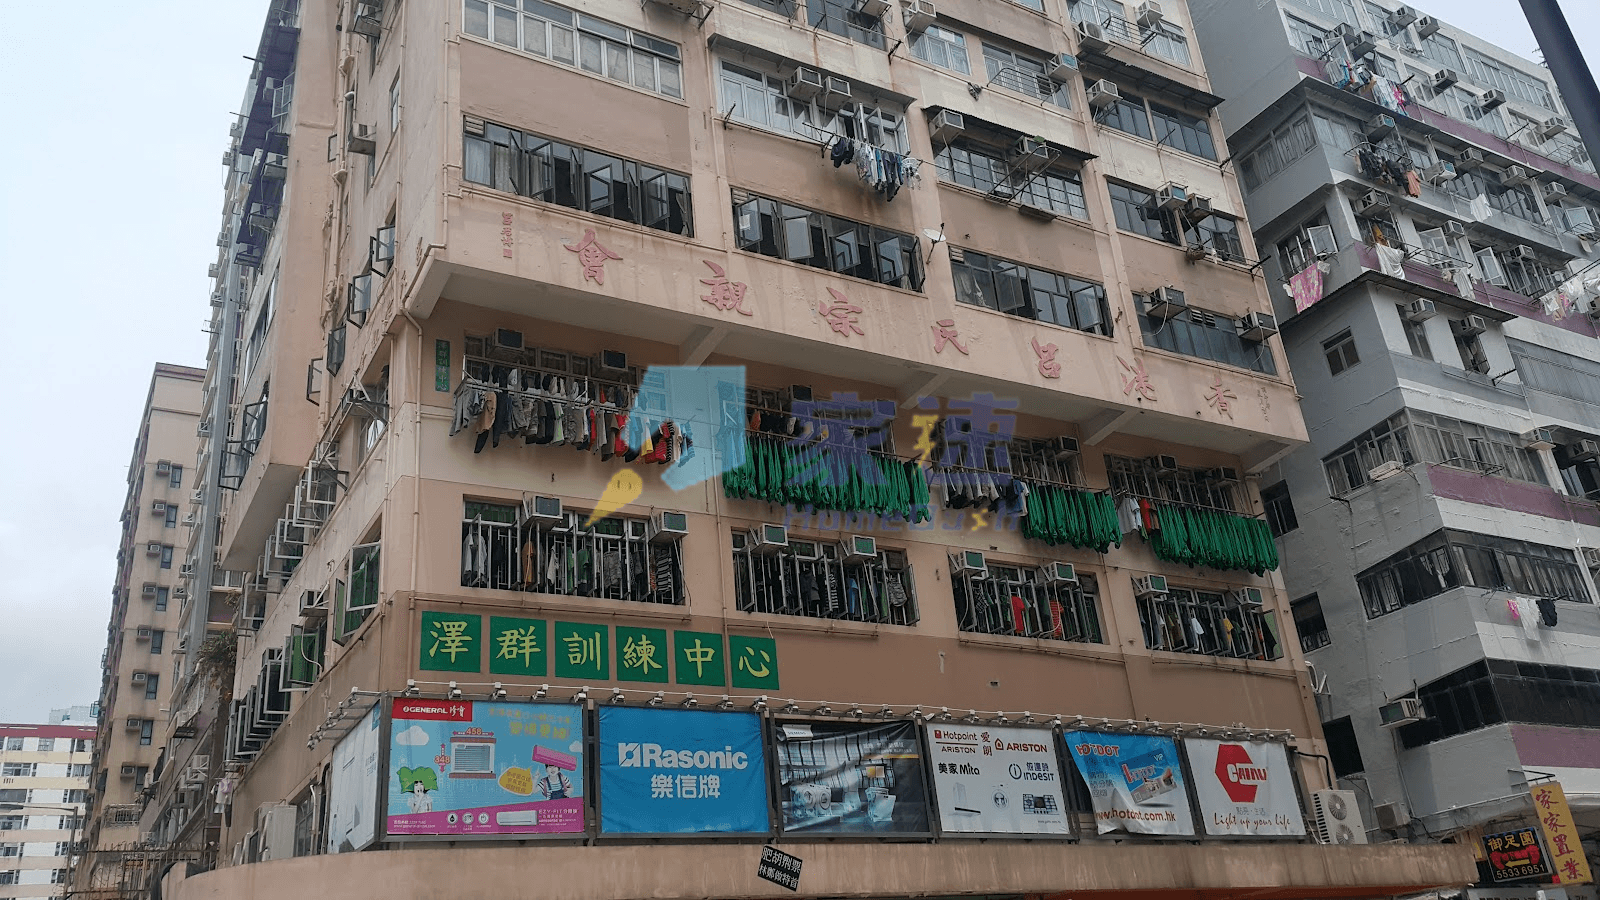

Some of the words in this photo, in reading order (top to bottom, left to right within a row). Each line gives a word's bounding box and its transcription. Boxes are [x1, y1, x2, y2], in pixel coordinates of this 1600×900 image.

[429, 619, 772, 679] 澤群訓練中心
[409, 706, 448, 714] GENERAL
[466, 727, 483, 735] 458
[943, 731, 978, 741] Hotpoint
[941, 746, 976, 754] ARISTON
[1007, 743, 1048, 753] ARISTON
[434, 755, 451, 764] 348
[643, 743, 748, 770] Rasonic
[651, 774, 720, 799] 樂信牌
[1214, 812, 1236, 829] Light
[1240, 818, 1250, 829] up
[1254, 819, 1272, 830] your
[1535, 789, 1583, 880] 家家置業
[1496, 867, 1520, 879] 5533
[1521, 864, 1545, 877] 6951
